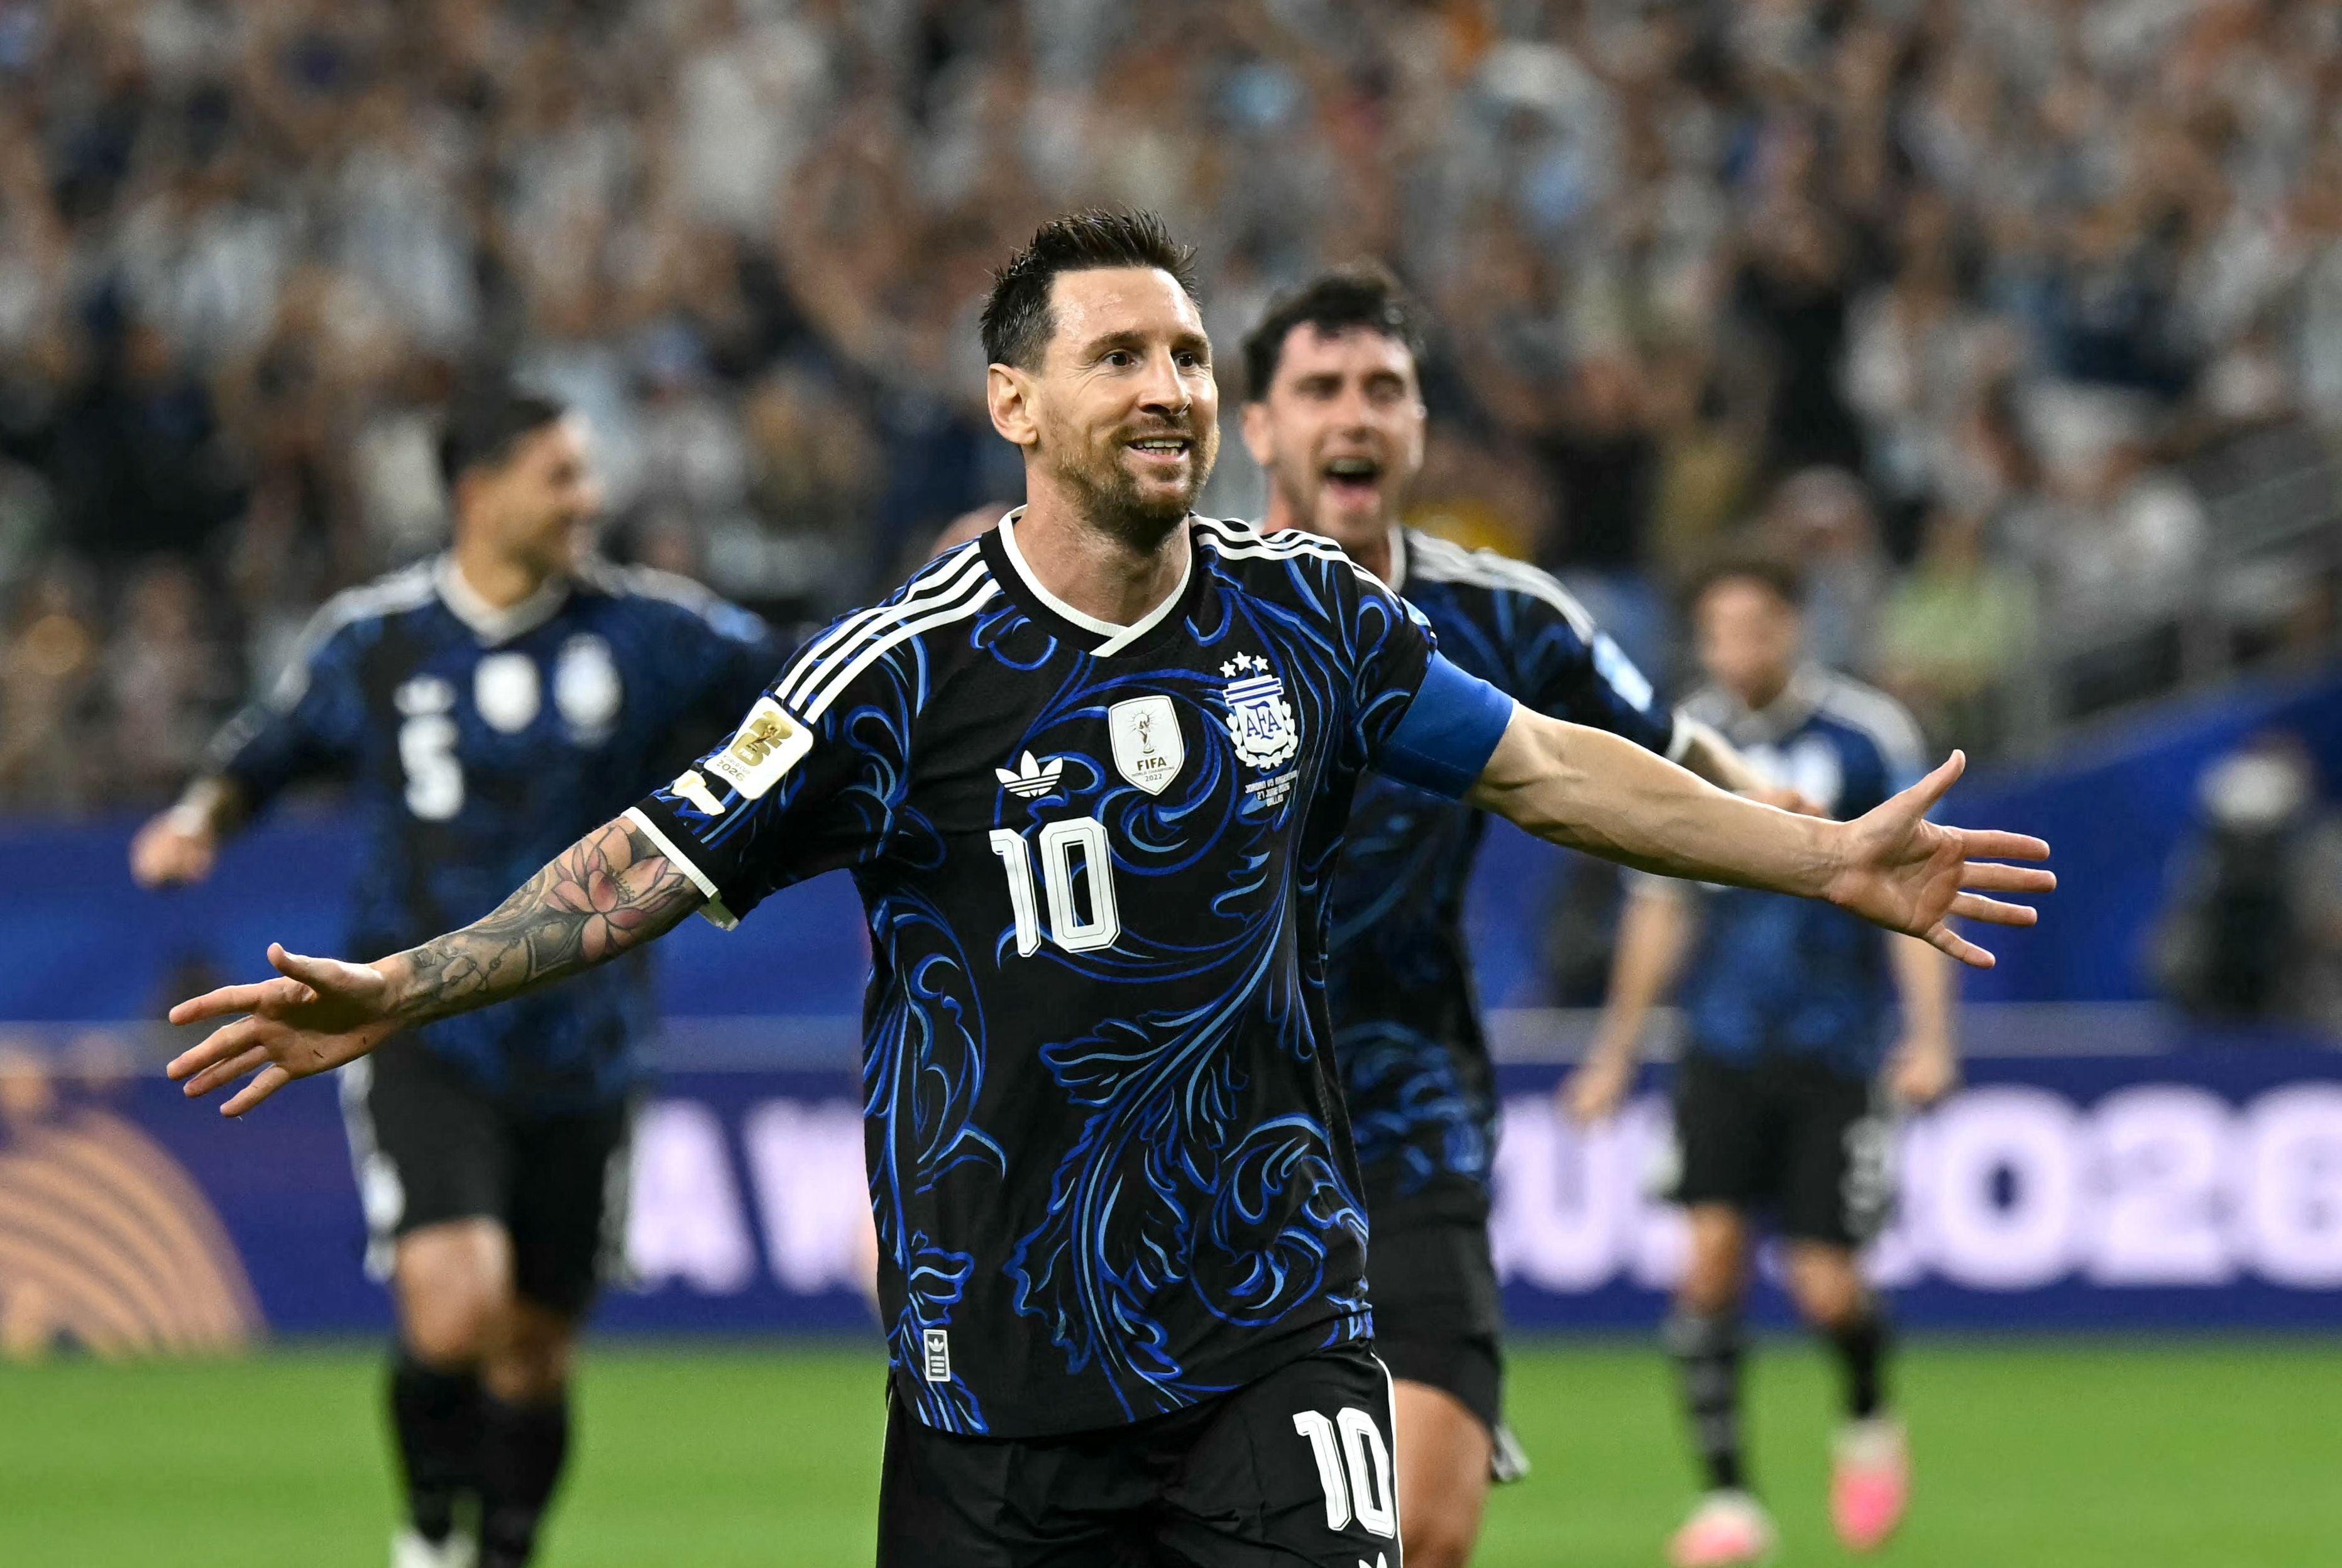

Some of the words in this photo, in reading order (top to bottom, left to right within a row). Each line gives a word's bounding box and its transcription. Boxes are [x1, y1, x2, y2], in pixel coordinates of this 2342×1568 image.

[1244, 701, 1283, 740] AFA
[399, 713, 465, 821] 5
[717, 760, 745, 781] 2026
[1136, 756, 1167, 771] FIFA
[1257, 791, 1265, 800] 27
[989, 816, 1120, 958] 10
[1292, 1407, 1395, 1539] 10
